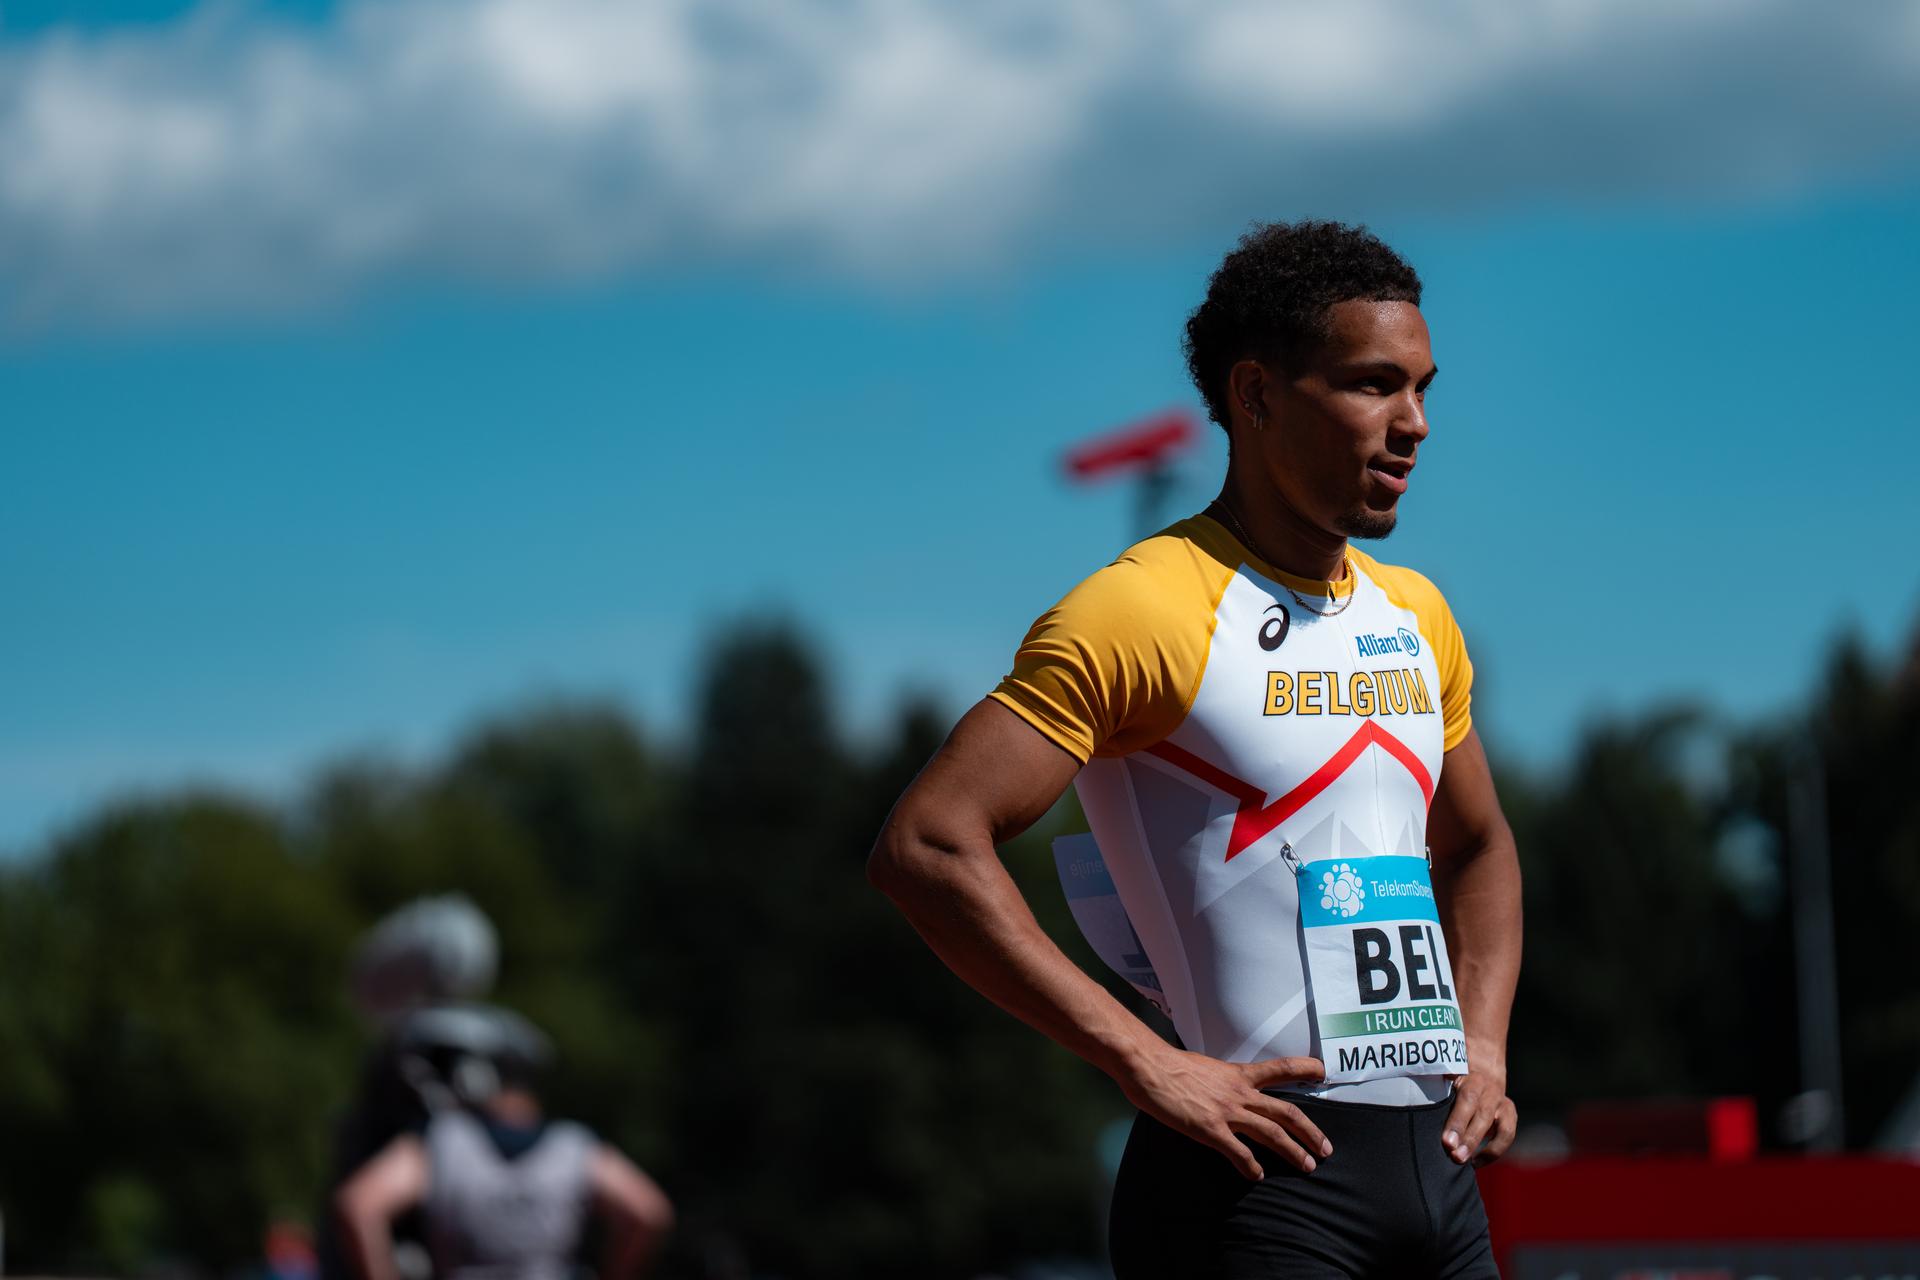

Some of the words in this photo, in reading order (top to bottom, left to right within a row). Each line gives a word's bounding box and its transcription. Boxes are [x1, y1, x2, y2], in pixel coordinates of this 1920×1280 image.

[1355, 634, 1402, 657] Allianz
[1263, 668, 1435, 717] BELGIUM
[1352, 925, 1453, 1005] BEL
[1365, 1015, 1371, 1031] I
[1376, 1010, 1416, 1030] RUN
[1339, 1039, 1451, 1072] MARIBOR
